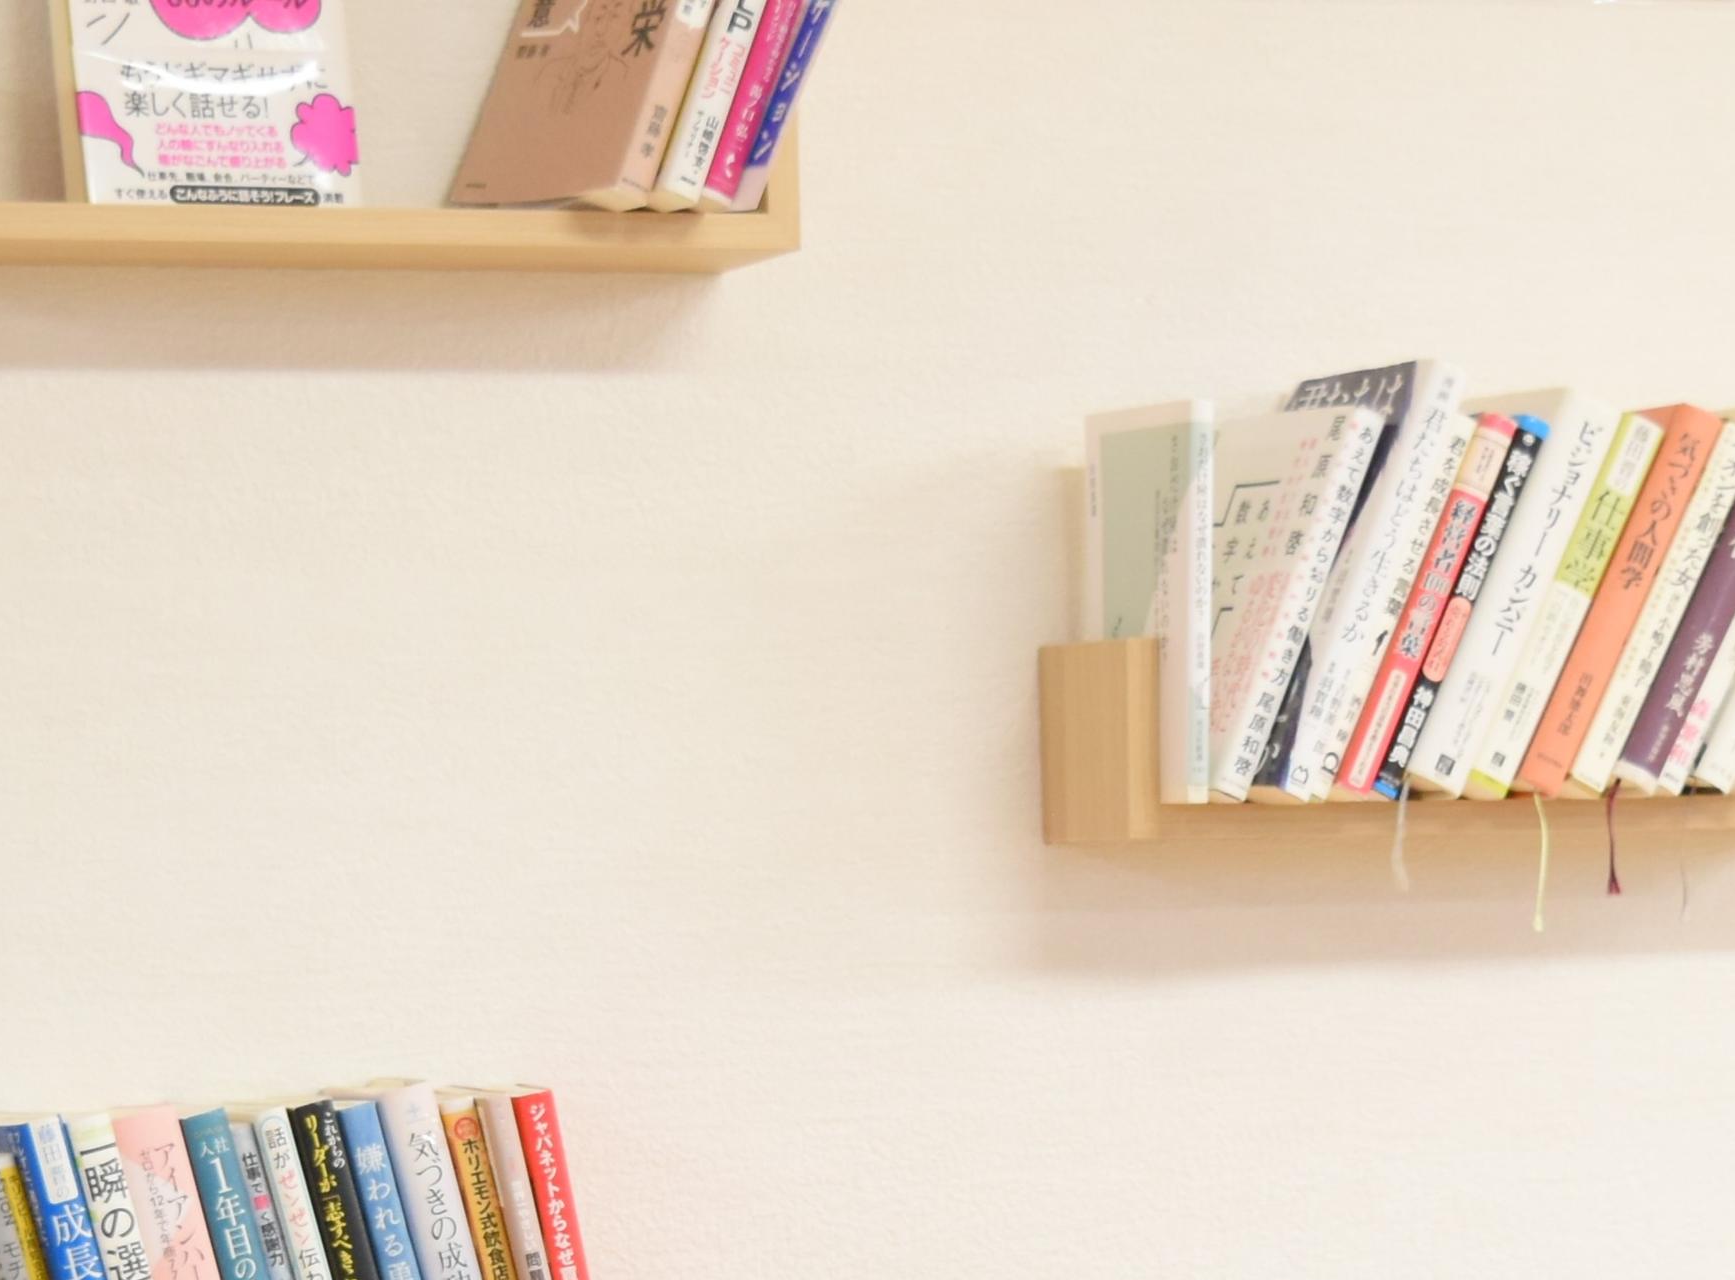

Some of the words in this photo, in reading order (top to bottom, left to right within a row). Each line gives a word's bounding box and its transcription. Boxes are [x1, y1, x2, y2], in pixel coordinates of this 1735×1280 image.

[1269, 423, 1376, 687] あえて数字からおりる働き方
[1339, 407, 1445, 645] 君たちはどう生きるか
[1384, 435, 1467, 617] 君を成長させる言葉
[1454, 449, 1531, 600] 稼ぐ言葉の法則
[1566, 490, 1625, 591] 仕事学
[1233, 691, 1275, 778] 尾原和啓
[1387, 685, 1434, 769] 神田昌典
[322, 1110, 347, 1170] これからの
[240, 1150, 286, 1268] 仕事でく感謝力
